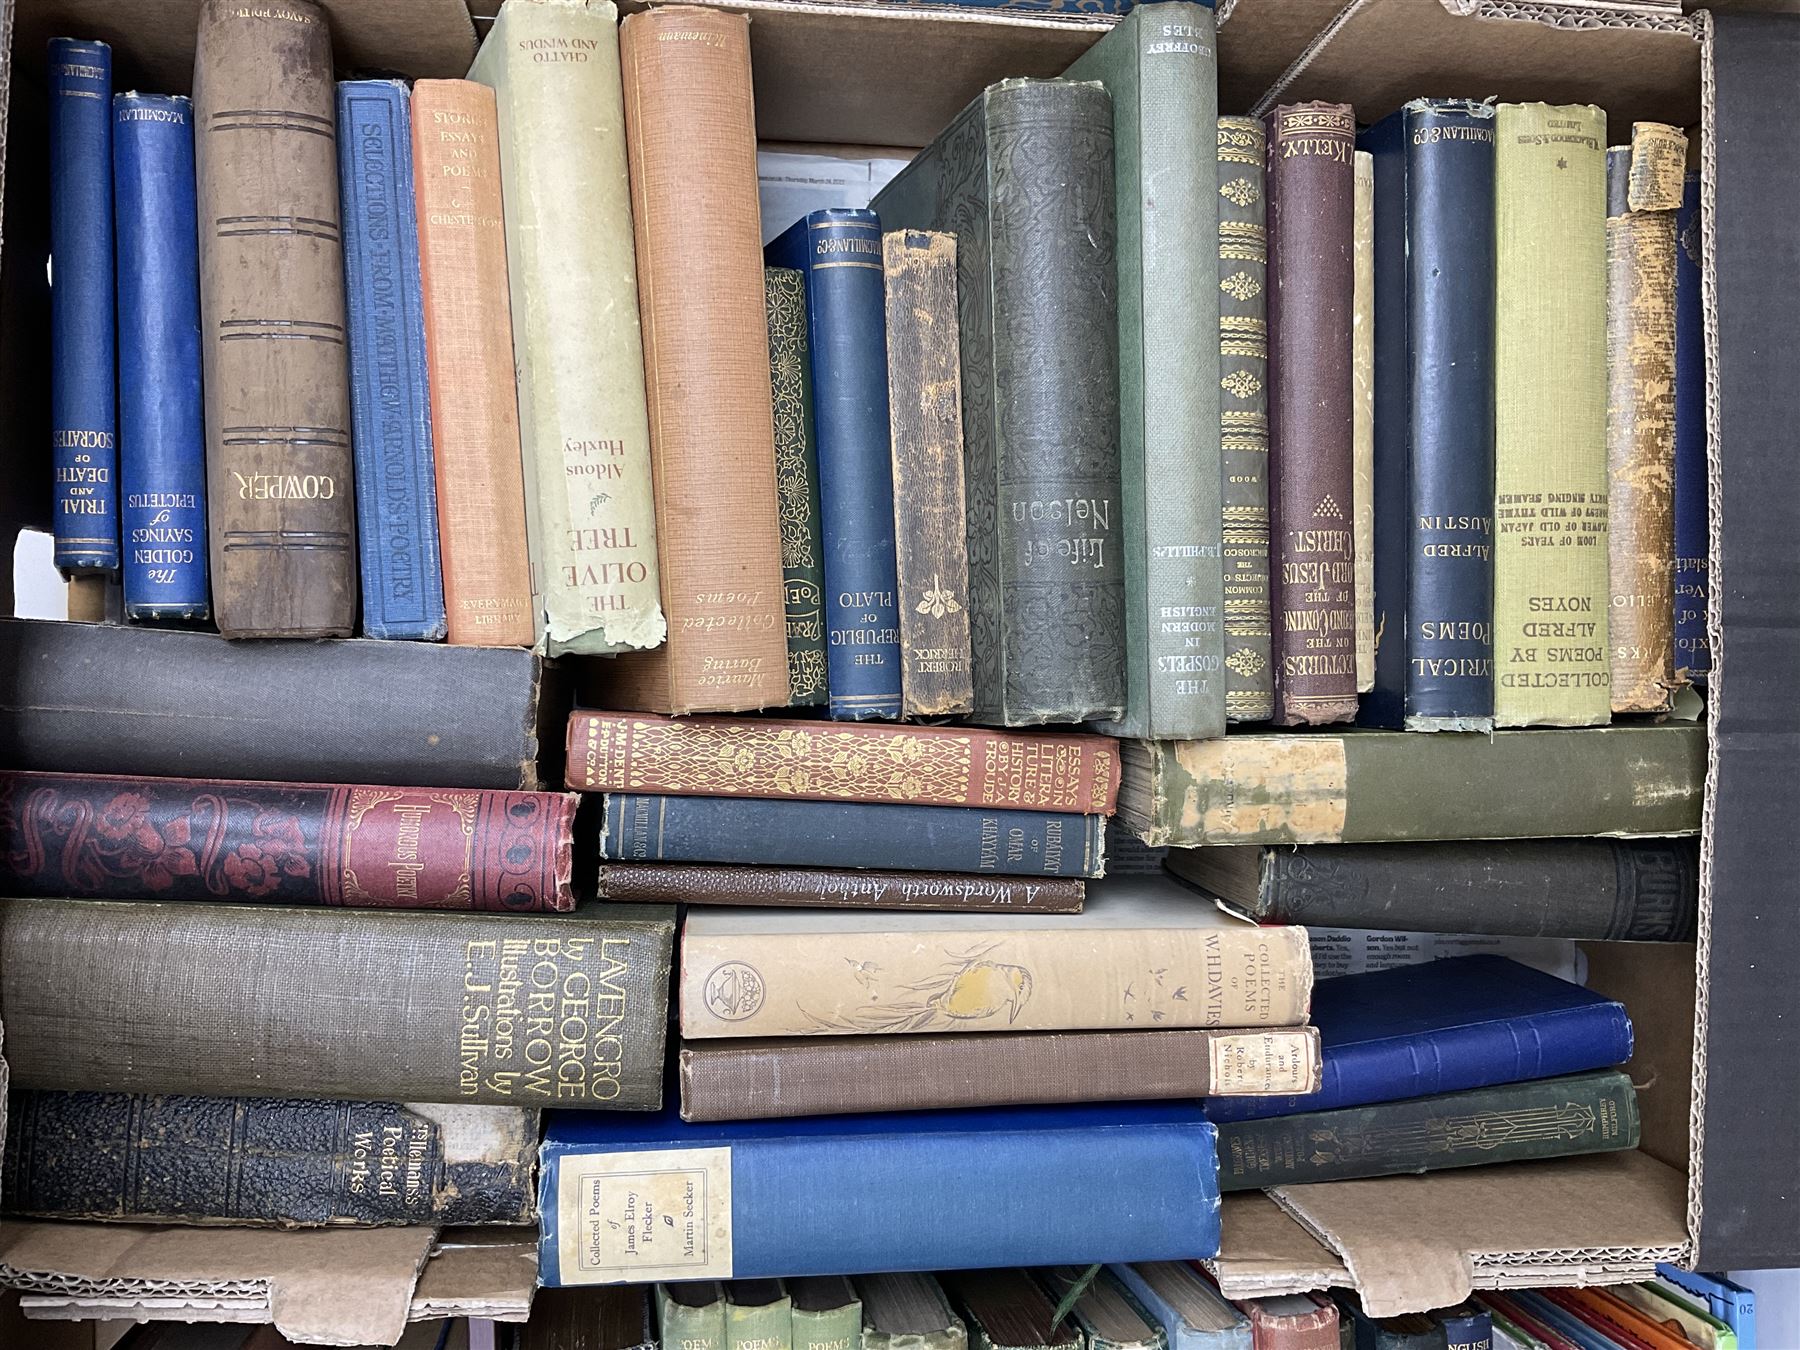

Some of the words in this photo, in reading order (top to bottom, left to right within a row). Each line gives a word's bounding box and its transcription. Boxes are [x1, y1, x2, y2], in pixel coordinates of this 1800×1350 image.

[273, 9, 311, 24] SAVOY
[519, 38, 568, 51] WINDUS
[571, 38, 599, 51] AND
[533, 51, 588, 64] CHATTO
[119, 108, 185, 124] MACMILLAN
[451, 149, 477, 160] AND
[362, 123, 390, 241] SELECTIONS
[370, 249, 395, 312] FROM
[374, 315, 403, 415] MATTHEW
[53, 430, 114, 449] SOCRATES
[562, 437, 625, 456] Huxley
[74, 454, 91, 464] OF
[56, 467, 109, 482] DEATH
[565, 462, 625, 479] Aldous
[1229, 475, 1258, 483] WOOD
[70, 487, 95, 496] AND
[233, 471, 335, 500] COWPER
[61, 498, 106, 514] TRIAL
[128, 493, 196, 509] EPICTETUS
[151, 509, 177, 526] of
[1012, 499, 1110, 530] Nelson
[1540, 507, 1567, 519] WILD
[1570, 507, 1582, 518] OF
[1420, 516, 1492, 535] AUSTIN
[1500, 522, 1534, 533] JAPAN
[1540, 521, 1561, 532] OLD
[1565, 521, 1577, 532] OF
[131, 528, 194, 544] SAYINGS
[566, 527, 637, 552] TREE
[1521, 536, 1555, 547] YEARS
[1559, 536, 1572, 547] OF
[1056, 538, 1105, 567] Life
[1289, 530, 1352, 561] CHRIST.
[1423, 544, 1490, 562] ALFRED
[133, 549, 194, 564] GOLDEN
[389, 520, 414, 603] POETRY
[1024, 541, 1050, 568] of
[1236, 561, 1253, 569] THE
[148, 568, 177, 584] The
[561, 560, 647, 588] OLIVE
[694, 591, 761, 606] Poems
[1224, 585, 1263, 595] COMMON
[1304, 591, 1330, 604] THE
[1336, 590, 1349, 603] OF
[585, 594, 630, 613] THE
[838, 591, 892, 608] PLATO
[1527, 596, 1592, 612] NOYES
[860, 613, 877, 624] OF
[1160, 605, 1218, 618] ENGLISH
[680, 613, 776, 633] Collected
[1160, 621, 1217, 633] MODERN
[1522, 622, 1597, 638] ALFRED
[831, 629, 899, 646] REPUBLIC
[1421, 621, 1492, 646] POEMS
[1184, 637, 1200, 648] IN
[1306, 637, 1332, 649] THE
[1336, 637, 1350, 649] ON
[853, 653, 884, 665] THE
[913, 648, 963, 661] HERRICK
[1509, 647, 1538, 663] BY
[1546, 647, 1604, 663] POEMS
[702, 657, 762, 673] Baring
[917, 660, 962, 673] ROBERT
[1158, 655, 1220, 672] GOSPELS
[1411, 657, 1494, 677] LYRICAL
[697, 674, 765, 690] Maurice
[1175, 680, 1208, 696] THE
[1500, 671, 1611, 688] COLLECTED
[982, 740, 998, 805] FROUDE
[997, 754, 1010, 776] BY
[1008, 742, 1025, 805] HISTORY
[1024, 742, 1040, 790] TURE
[1066, 745, 1082, 807] ESSAYS
[1022, 790, 1035, 805] &
[1052, 789, 1066, 807] IN
[979, 818, 999, 869] KHAYYÁM
[1007, 827, 1025, 863] OMAR
[1030, 839, 1040, 853] OF
[902, 883, 1012, 904] Wordsworth
[1025, 886, 1040, 904] A
[1629, 851, 1679, 936] BURNS
[1366, 935, 1393, 943] Gordon
[560, 938, 595, 961] by
[1230, 977, 1239, 990] OF
[1243, 953, 1258, 1013] POEMS
[1258, 943, 1270, 1021] COLLECTED
[1278, 970, 1287, 992] THE
[494, 939, 532, 1060] Illustrations
[523, 938, 561, 1098] BORROW
[591, 937, 631, 1101] LAVENGRO
[556, 971, 591, 1099] GEORGE
[1247, 1059, 1258, 1071] by
[1278, 1055, 1288, 1073] and
[1290, 1044, 1301, 1084] Ardours
[485, 1071, 522, 1096] by
[1599, 1098, 1610, 1140] HUMPHREY
[1609, 1100, 1619, 1136] MILFORD
[350, 1131, 374, 1194] Works
[379, 1127, 403, 1196] Poetical
[589, 1178, 601, 1216] Poems
[624, 1190, 639, 1221] Elroy
[682, 1179, 695, 1218] Secker
[607, 1218, 622, 1231] of
[642, 1200, 655, 1244] Flecker
[590, 1219, 602, 1267] Collected
[625, 1222, 639, 1256] James
[682, 1222, 695, 1258] Martin
[1739, 1303, 1754, 1315] 20
